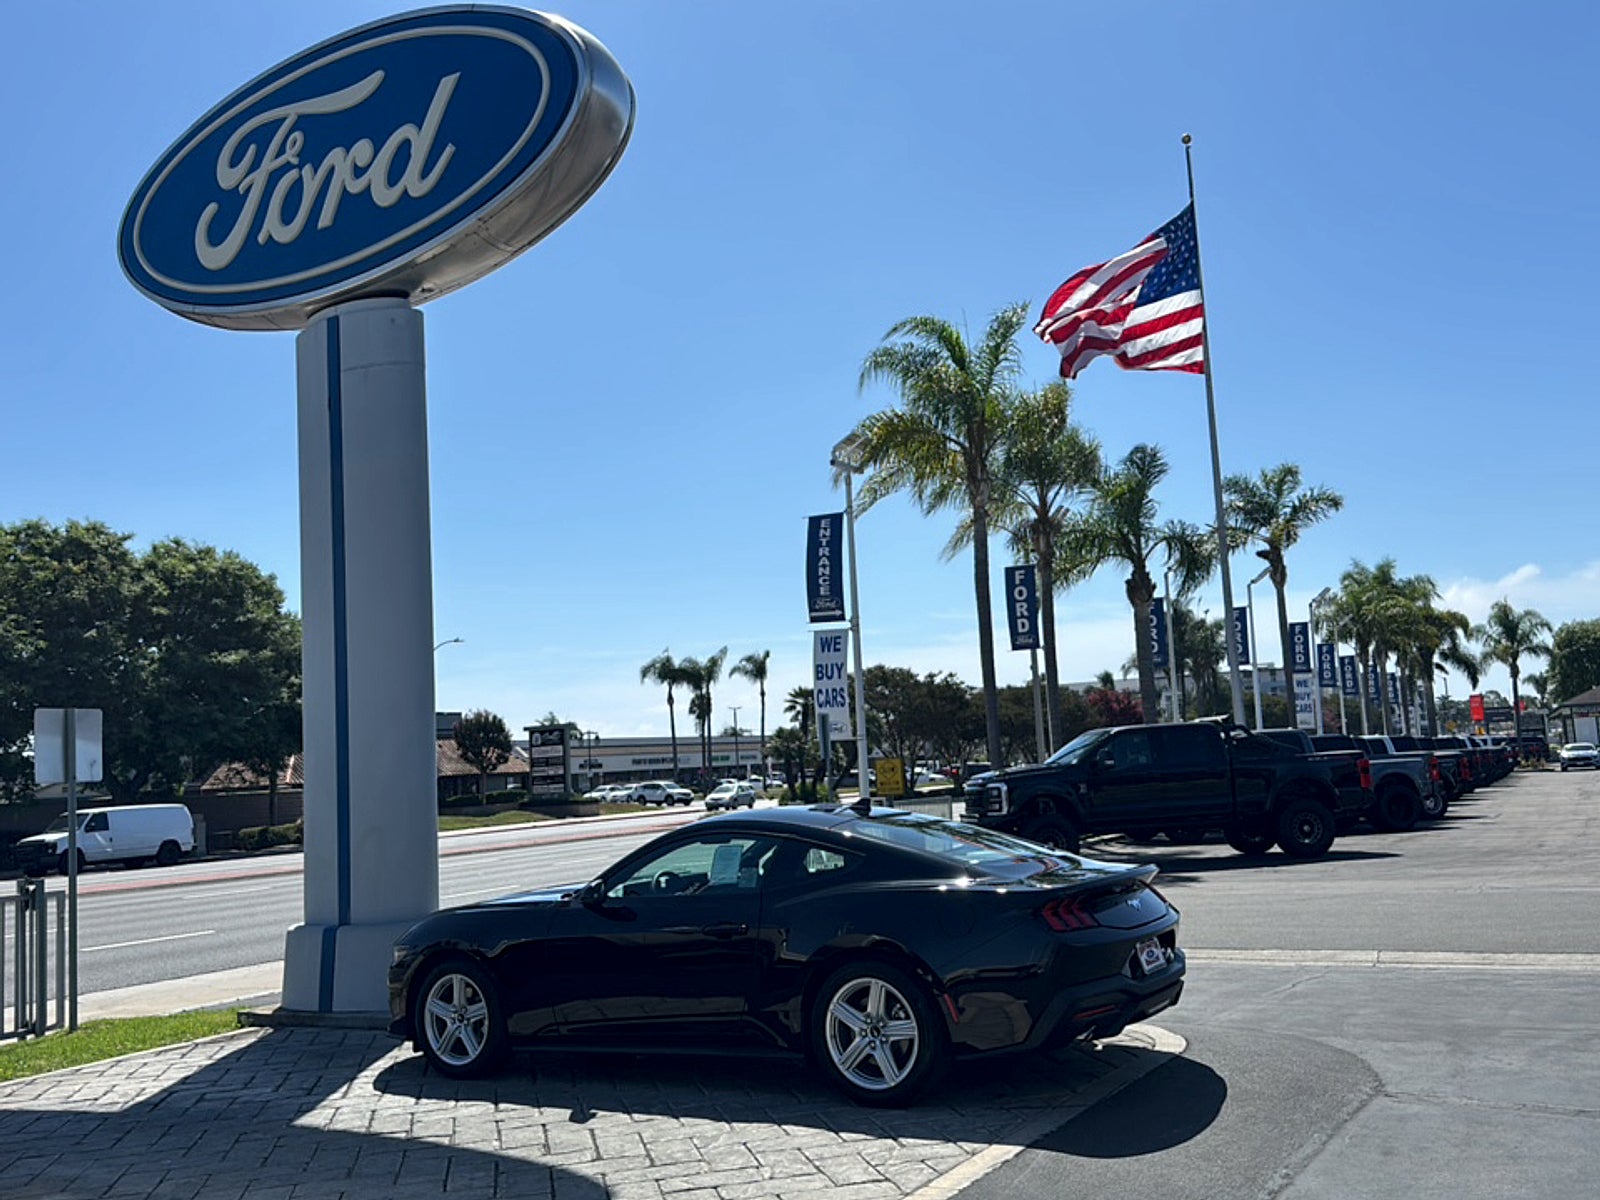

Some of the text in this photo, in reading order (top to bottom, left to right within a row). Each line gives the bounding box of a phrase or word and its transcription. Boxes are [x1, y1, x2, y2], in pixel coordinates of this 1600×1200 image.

[195, 69, 462, 271] Ford
[818, 518, 832, 596] ENTRANCE
[1014, 569, 1030, 633] FORD
[820, 635, 842, 653] WE
[1294, 625, 1305, 663] FORD
[816, 662, 845, 681] BUY
[1322, 645, 1332, 679] FORD
[1344, 658, 1354, 688] FORD
[816, 686, 846, 708] CARS
